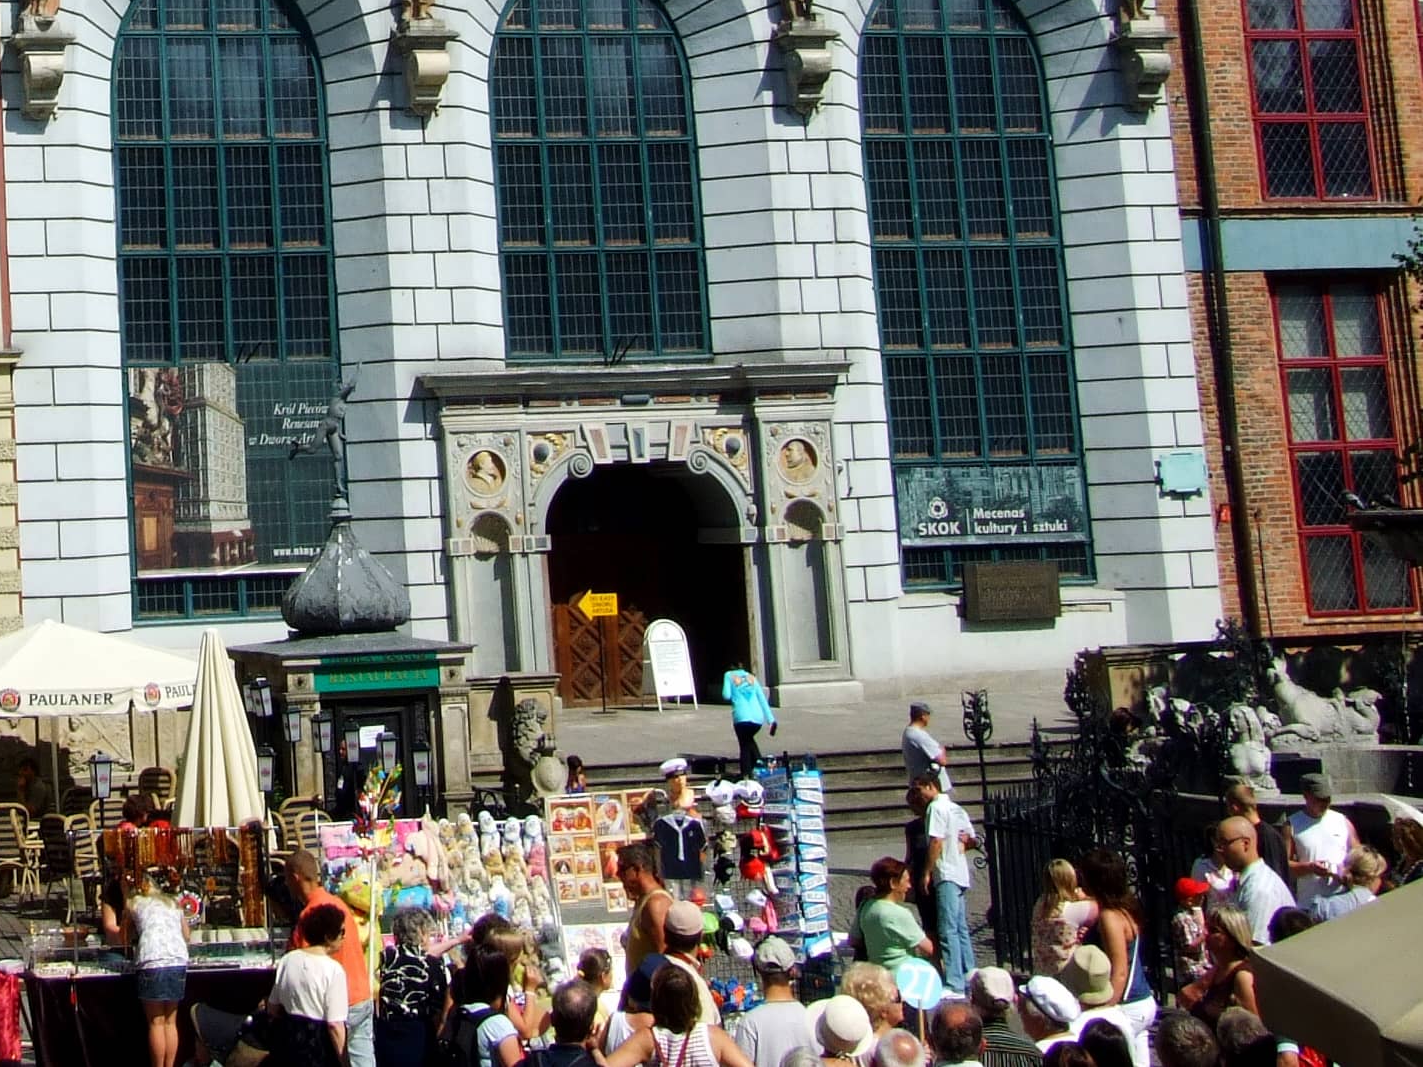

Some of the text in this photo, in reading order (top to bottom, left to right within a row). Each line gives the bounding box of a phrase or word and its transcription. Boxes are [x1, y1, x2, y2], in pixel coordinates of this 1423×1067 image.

[973, 508, 1025, 520] Mecenas
[918, 521, 961, 536] SKOK
[974, 519, 1068, 537] kultury i sztuki
[29, 693, 114, 706] PAULANER
[900, 963, 937, 1001] 27
